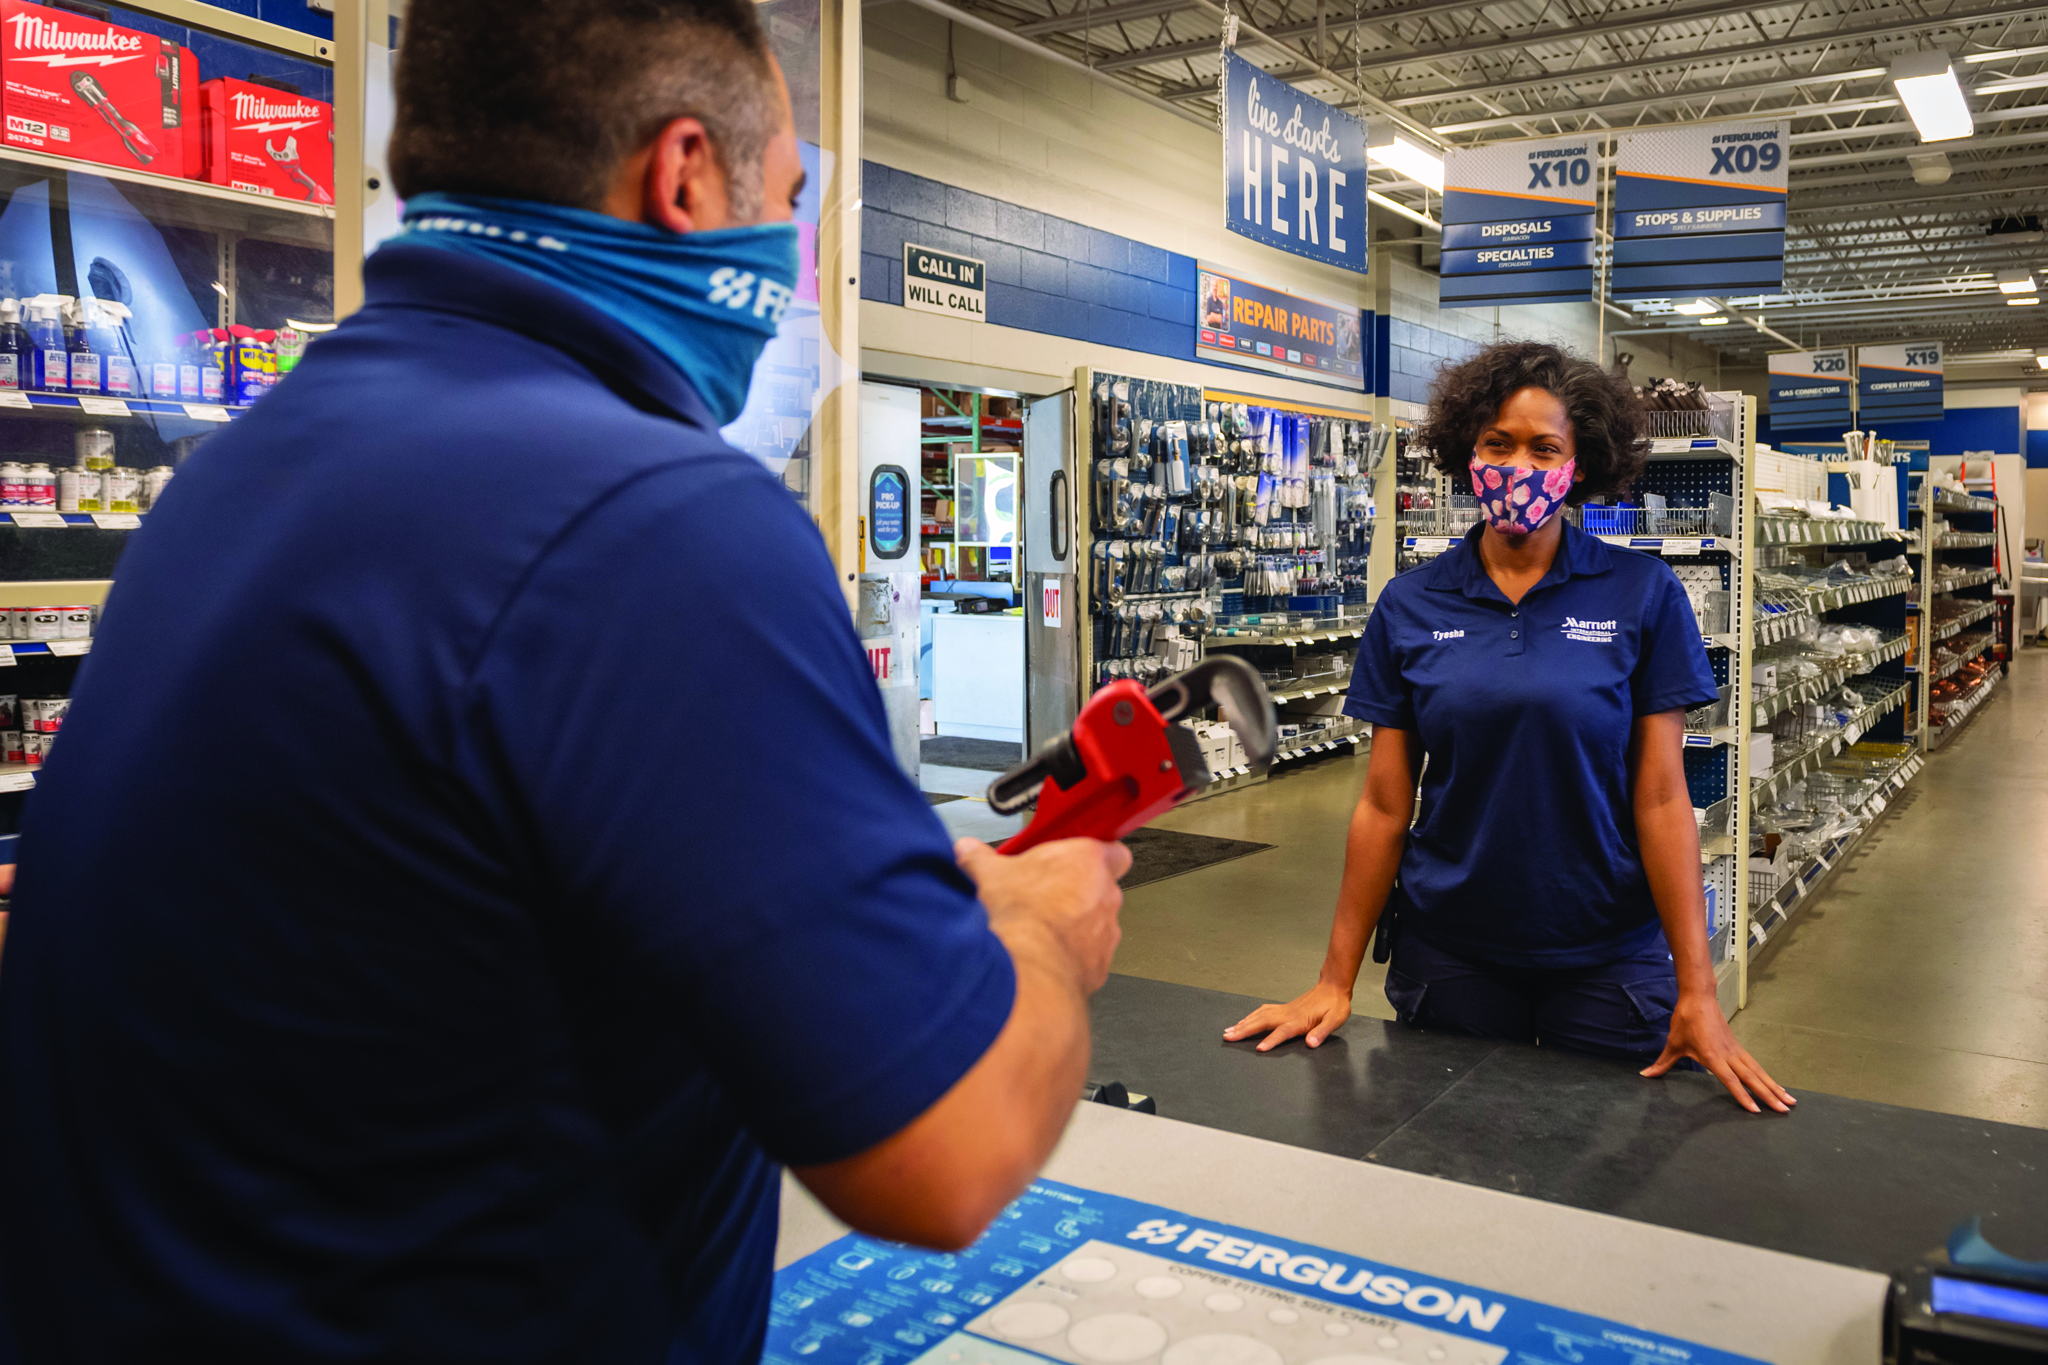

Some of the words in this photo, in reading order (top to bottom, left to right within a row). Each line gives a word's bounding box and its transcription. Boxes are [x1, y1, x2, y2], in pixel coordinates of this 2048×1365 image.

[5, 12, 142, 50] Milwaukee
[230, 91, 320, 120] Milwaukee
[10, 119, 43, 134] M12
[1248, 77, 1280, 137] line
[1283, 104, 1341, 163] starts
[1721, 131, 1779, 143] FERGUSON
[1536, 147, 1588, 158] FERGUSON
[1709, 142, 1782, 175] X09
[1527, 158, 1591, 190] X10
[1243, 130, 1346, 254] HERE
[1635, 213, 1678, 226] STOPS
[1682, 211, 1693, 223] &
[1696, 207, 1761, 222] SUPPLIES
[1481, 221, 1552, 237] DISPOSALS
[1477, 247, 1554, 263] SPECIALTIES
[918, 256, 956, 280] CALL
[959, 265, 975, 284] IN
[909, 284, 943, 306] WILL
[948, 293, 983, 314] CALL
[1233, 296, 1288, 335] REPAIR
[1291, 312, 1335, 346] PARTS
[1813, 358, 1846, 373] X20
[1905, 351, 1939, 366] X19
[1779, 389, 1793, 397] GAS
[1795, 386, 1840, 395] CONNECTORS
[1870, 382, 1897, 390] COPPER
[1898, 380, 1930, 388] FITTINGS
[1822, 453, 1851, 463] KNO
[881, 493, 895, 501] PRO
[1045, 588, 1060, 619] OUT
[1561, 617, 1617, 630] Marriott
[1432, 629, 1465, 641] Tyesha
[868, 646, 891, 680] UT
[1178, 1226, 1507, 1333] FERGUSON
[1168, 1265, 1232, 1287] COPPER
[1233, 1282, 1297, 1305] FITTING
[1339, 1311, 1400, 1331] CHART
